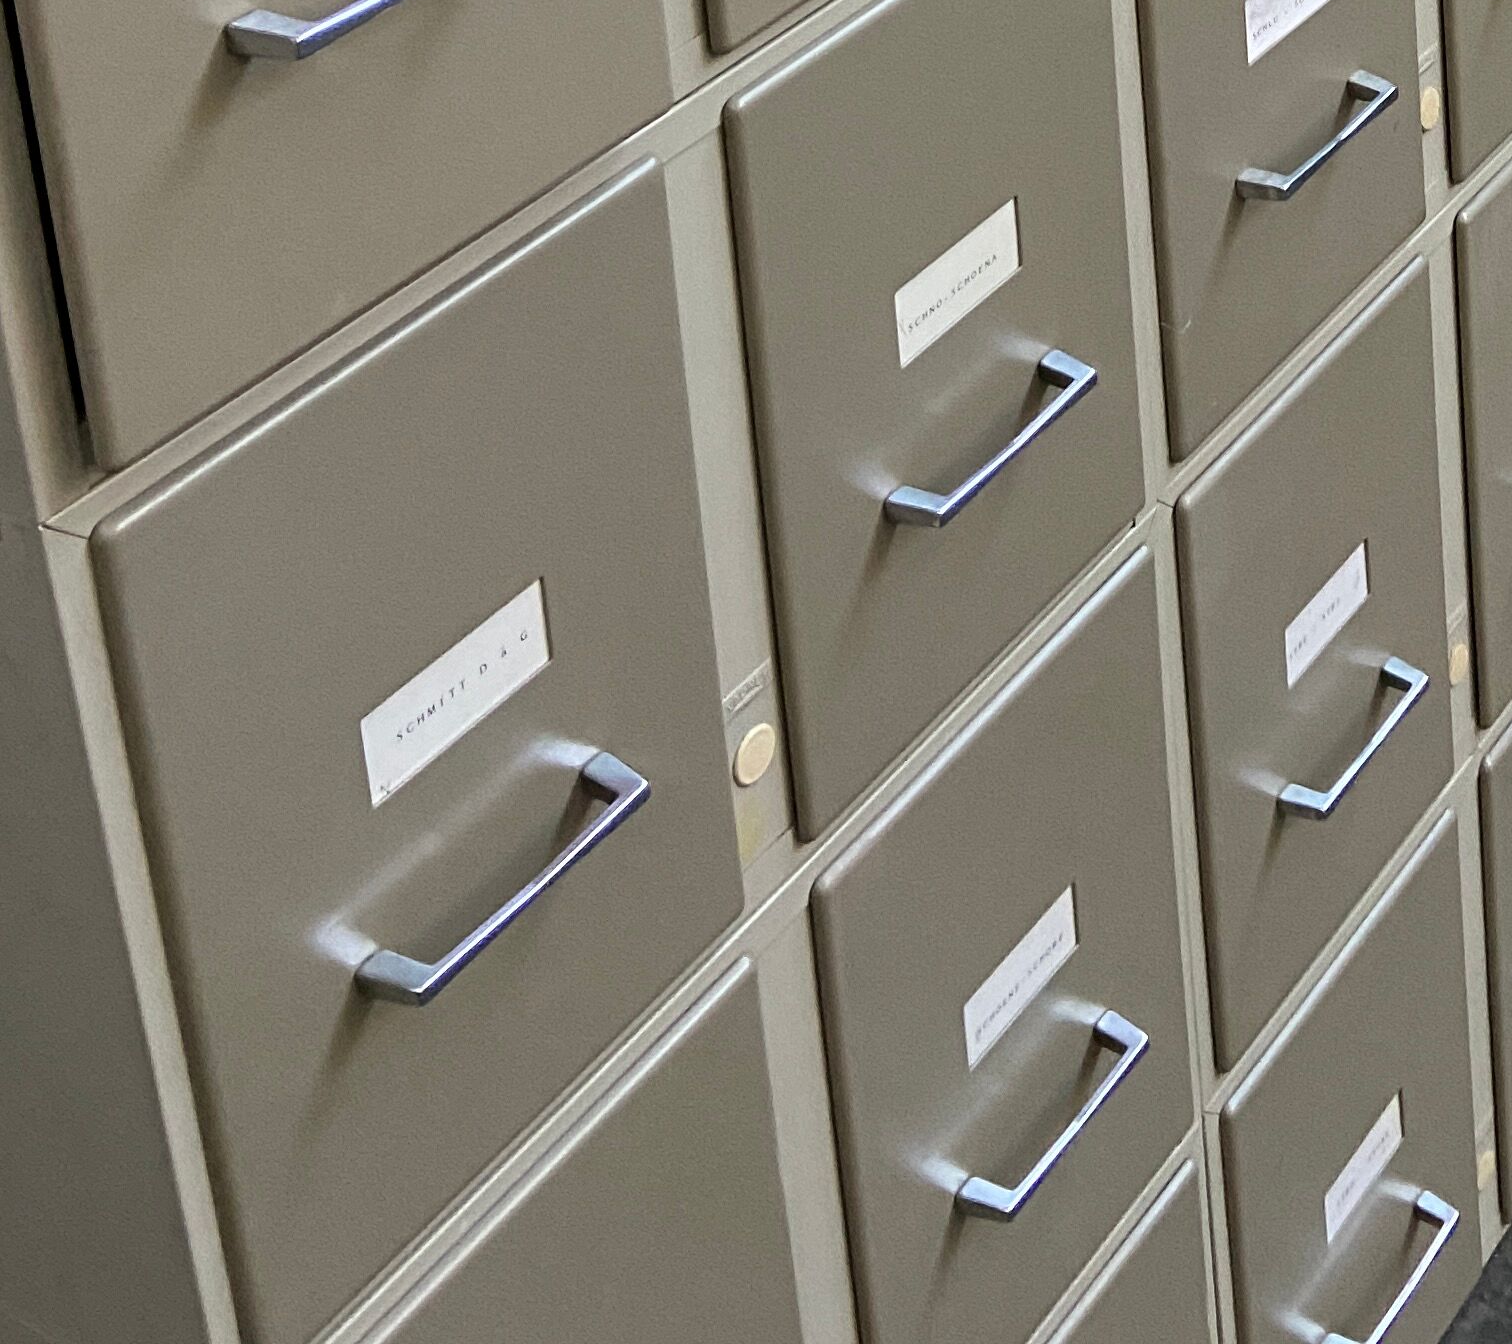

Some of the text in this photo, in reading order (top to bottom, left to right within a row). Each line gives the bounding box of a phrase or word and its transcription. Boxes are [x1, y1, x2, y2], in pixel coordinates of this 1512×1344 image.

[397, 680, 467, 742] SCHMITT
[480, 663, 490, 675] D
[520, 630, 529, 641] G
